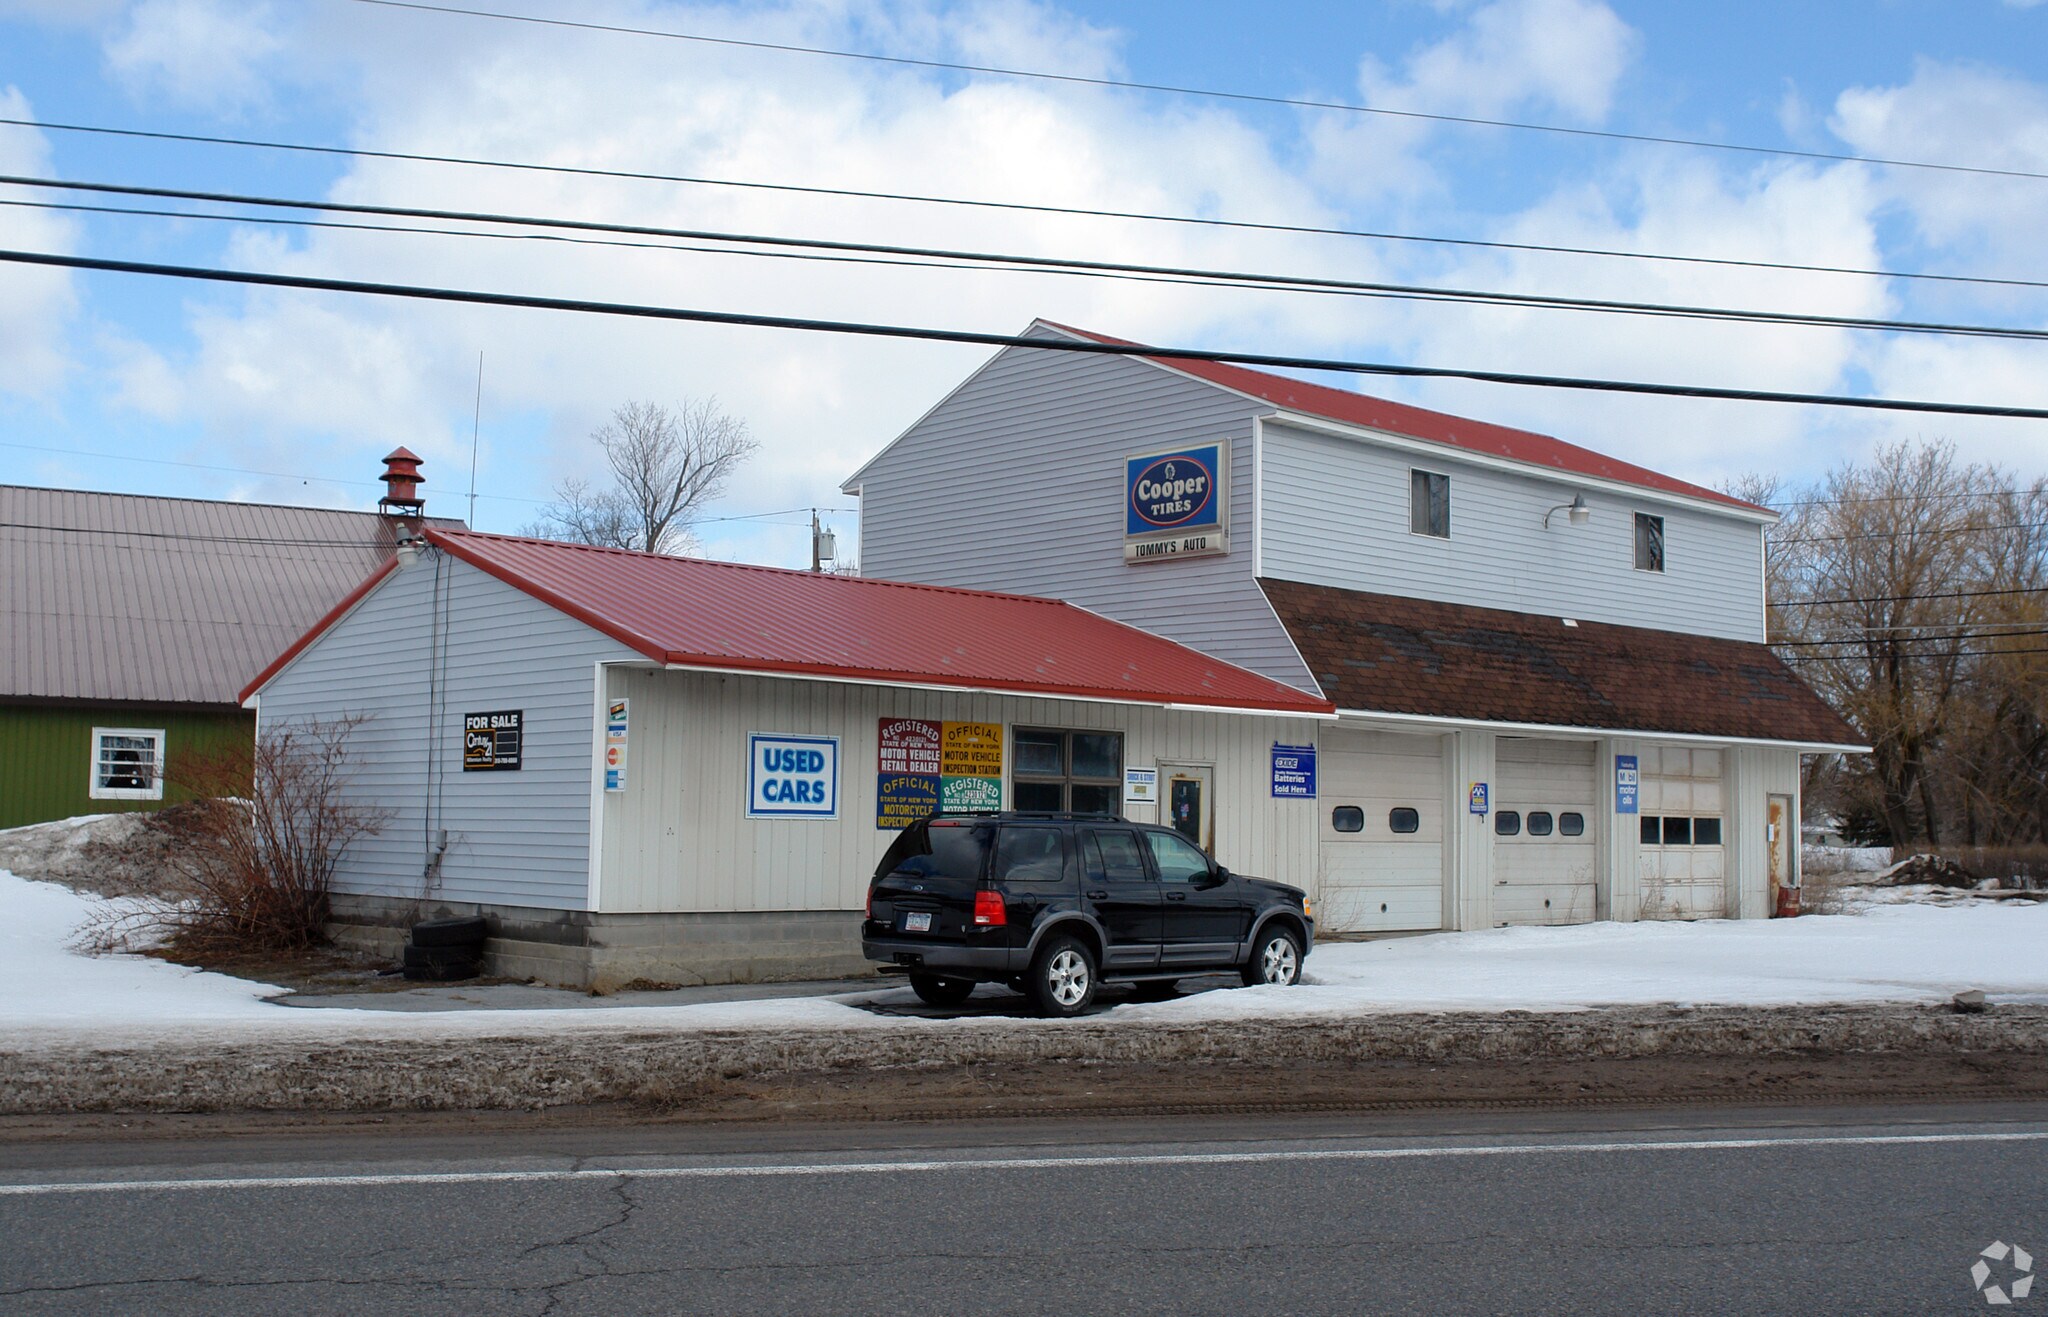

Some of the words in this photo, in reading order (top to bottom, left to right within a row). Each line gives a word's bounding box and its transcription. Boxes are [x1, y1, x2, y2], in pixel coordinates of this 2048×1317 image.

[1138, 475, 1206, 501] Cooper
[1151, 500, 1192, 516] TIRES
[1135, 541, 1177, 557] TOMMY'S
[1183, 537, 1206, 551] AUTO
[466, 716, 488, 729] FOR
[491, 714, 518, 728] SALE
[882, 720, 939, 741] REGISTERED
[948, 725, 998, 742] OFFICIAL
[467, 733, 489, 748] Century
[763, 747, 825, 774] USED
[880, 748, 907, 759] MOTOR
[910, 749, 940, 761] VEHICLE
[945, 750, 968, 760] MOTOR
[971, 751, 1000, 762] VEHICLE
[881, 760, 908, 771] RETAIL
[910, 761, 938, 773] DEALER
[943, 763, 977, 774] INSPECTION
[978, 765, 1001, 775] STATION
[1276, 758, 1298, 768] EXIDE
[1274, 774, 1305, 783] Batteries
[1619, 772, 1636, 782] Mbil
[762, 778, 825, 804] CARS
[883, 777, 936, 795] OFFICIAL
[943, 778, 999, 798] REGISTERED
[1274, 784, 1289, 793] Sold
[1291, 785, 1307, 794] Here
[1619, 785, 1636, 795] motor
[880, 795, 897, 803] STATE
[884, 803, 934, 816] MOTORCYCLE
